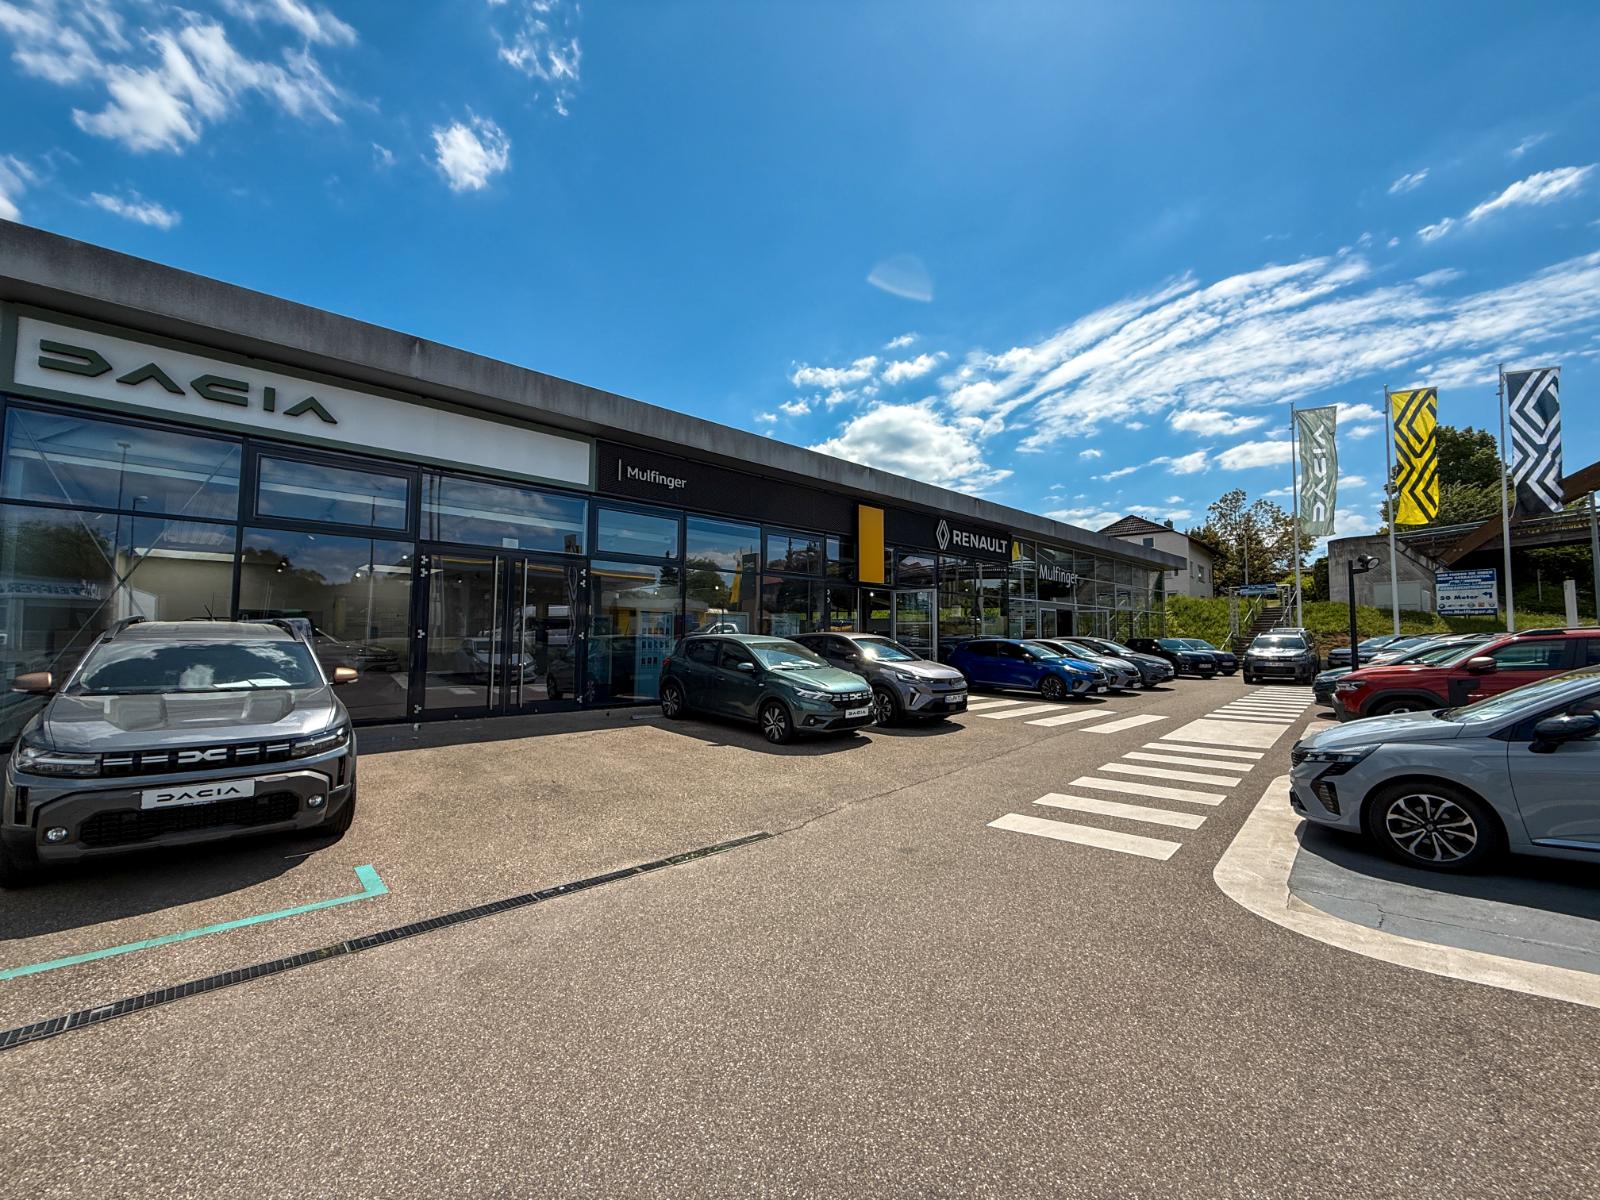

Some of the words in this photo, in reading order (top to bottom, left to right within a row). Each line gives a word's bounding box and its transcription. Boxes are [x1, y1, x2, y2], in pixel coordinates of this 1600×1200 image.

[38, 339, 338, 425] DACIA
[627, 466, 687, 489] Mulfinger
[1312, 424, 1327, 522] DACIA
[953, 530, 1007, 553] RENAULT
[1040, 564, 1079, 588] Mulfinger
[156, 787, 240, 802] DACIA
